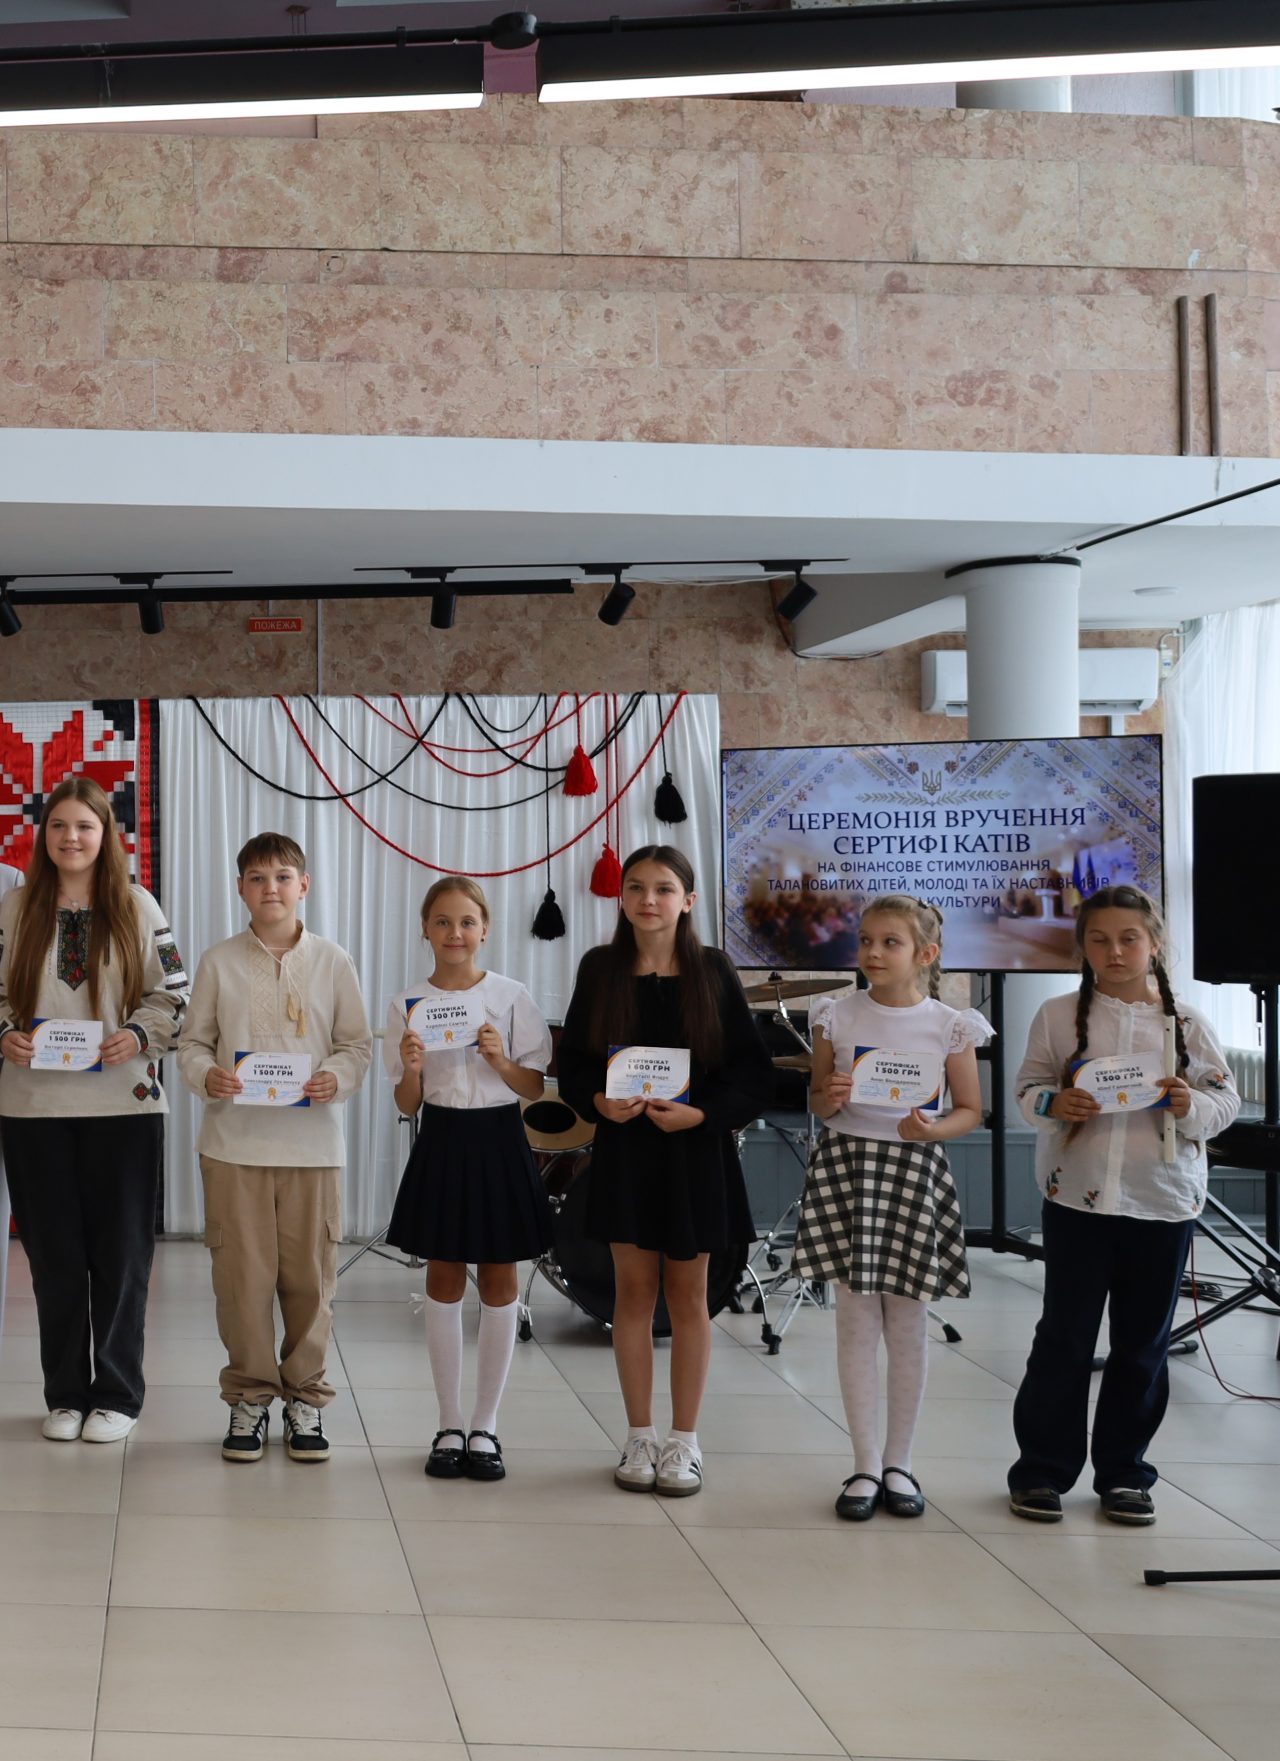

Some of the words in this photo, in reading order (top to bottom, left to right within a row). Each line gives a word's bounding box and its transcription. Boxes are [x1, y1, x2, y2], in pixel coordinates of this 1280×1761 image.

[254, 620, 297, 630] ПОЖЕЖА
[788, 810, 937, 834] ЦЕРЕМОНІЯ
[945, 807, 1086, 828] ВРУЧЕННЯ
[817, 862, 837, 873] НА
[840, 860, 922, 873] ФІНАНСОВЕ
[927, 859, 1050, 872] СТИМУЛЮВАННЯ
[768, 879, 864, 891] ТАЛАНОВИТИХ
[867, 876, 910, 892] ДІТЕЙ,
[914, 877, 968, 892] МОЛОДІ
[972, 878, 988, 890] ТА
[991, 875, 1005, 890] ЇХ
[426, 1005, 465, 1013] СЕРТИФІКАТ
[450, 1010, 467, 1018] ГРН
[875, 1061, 919, 1069] СЕРТИФІКАТ
[881, 1067, 898, 1075] 500
[901, 1068, 921, 1077] ГРН
[1123, 1071, 1144, 1080] ГРН
